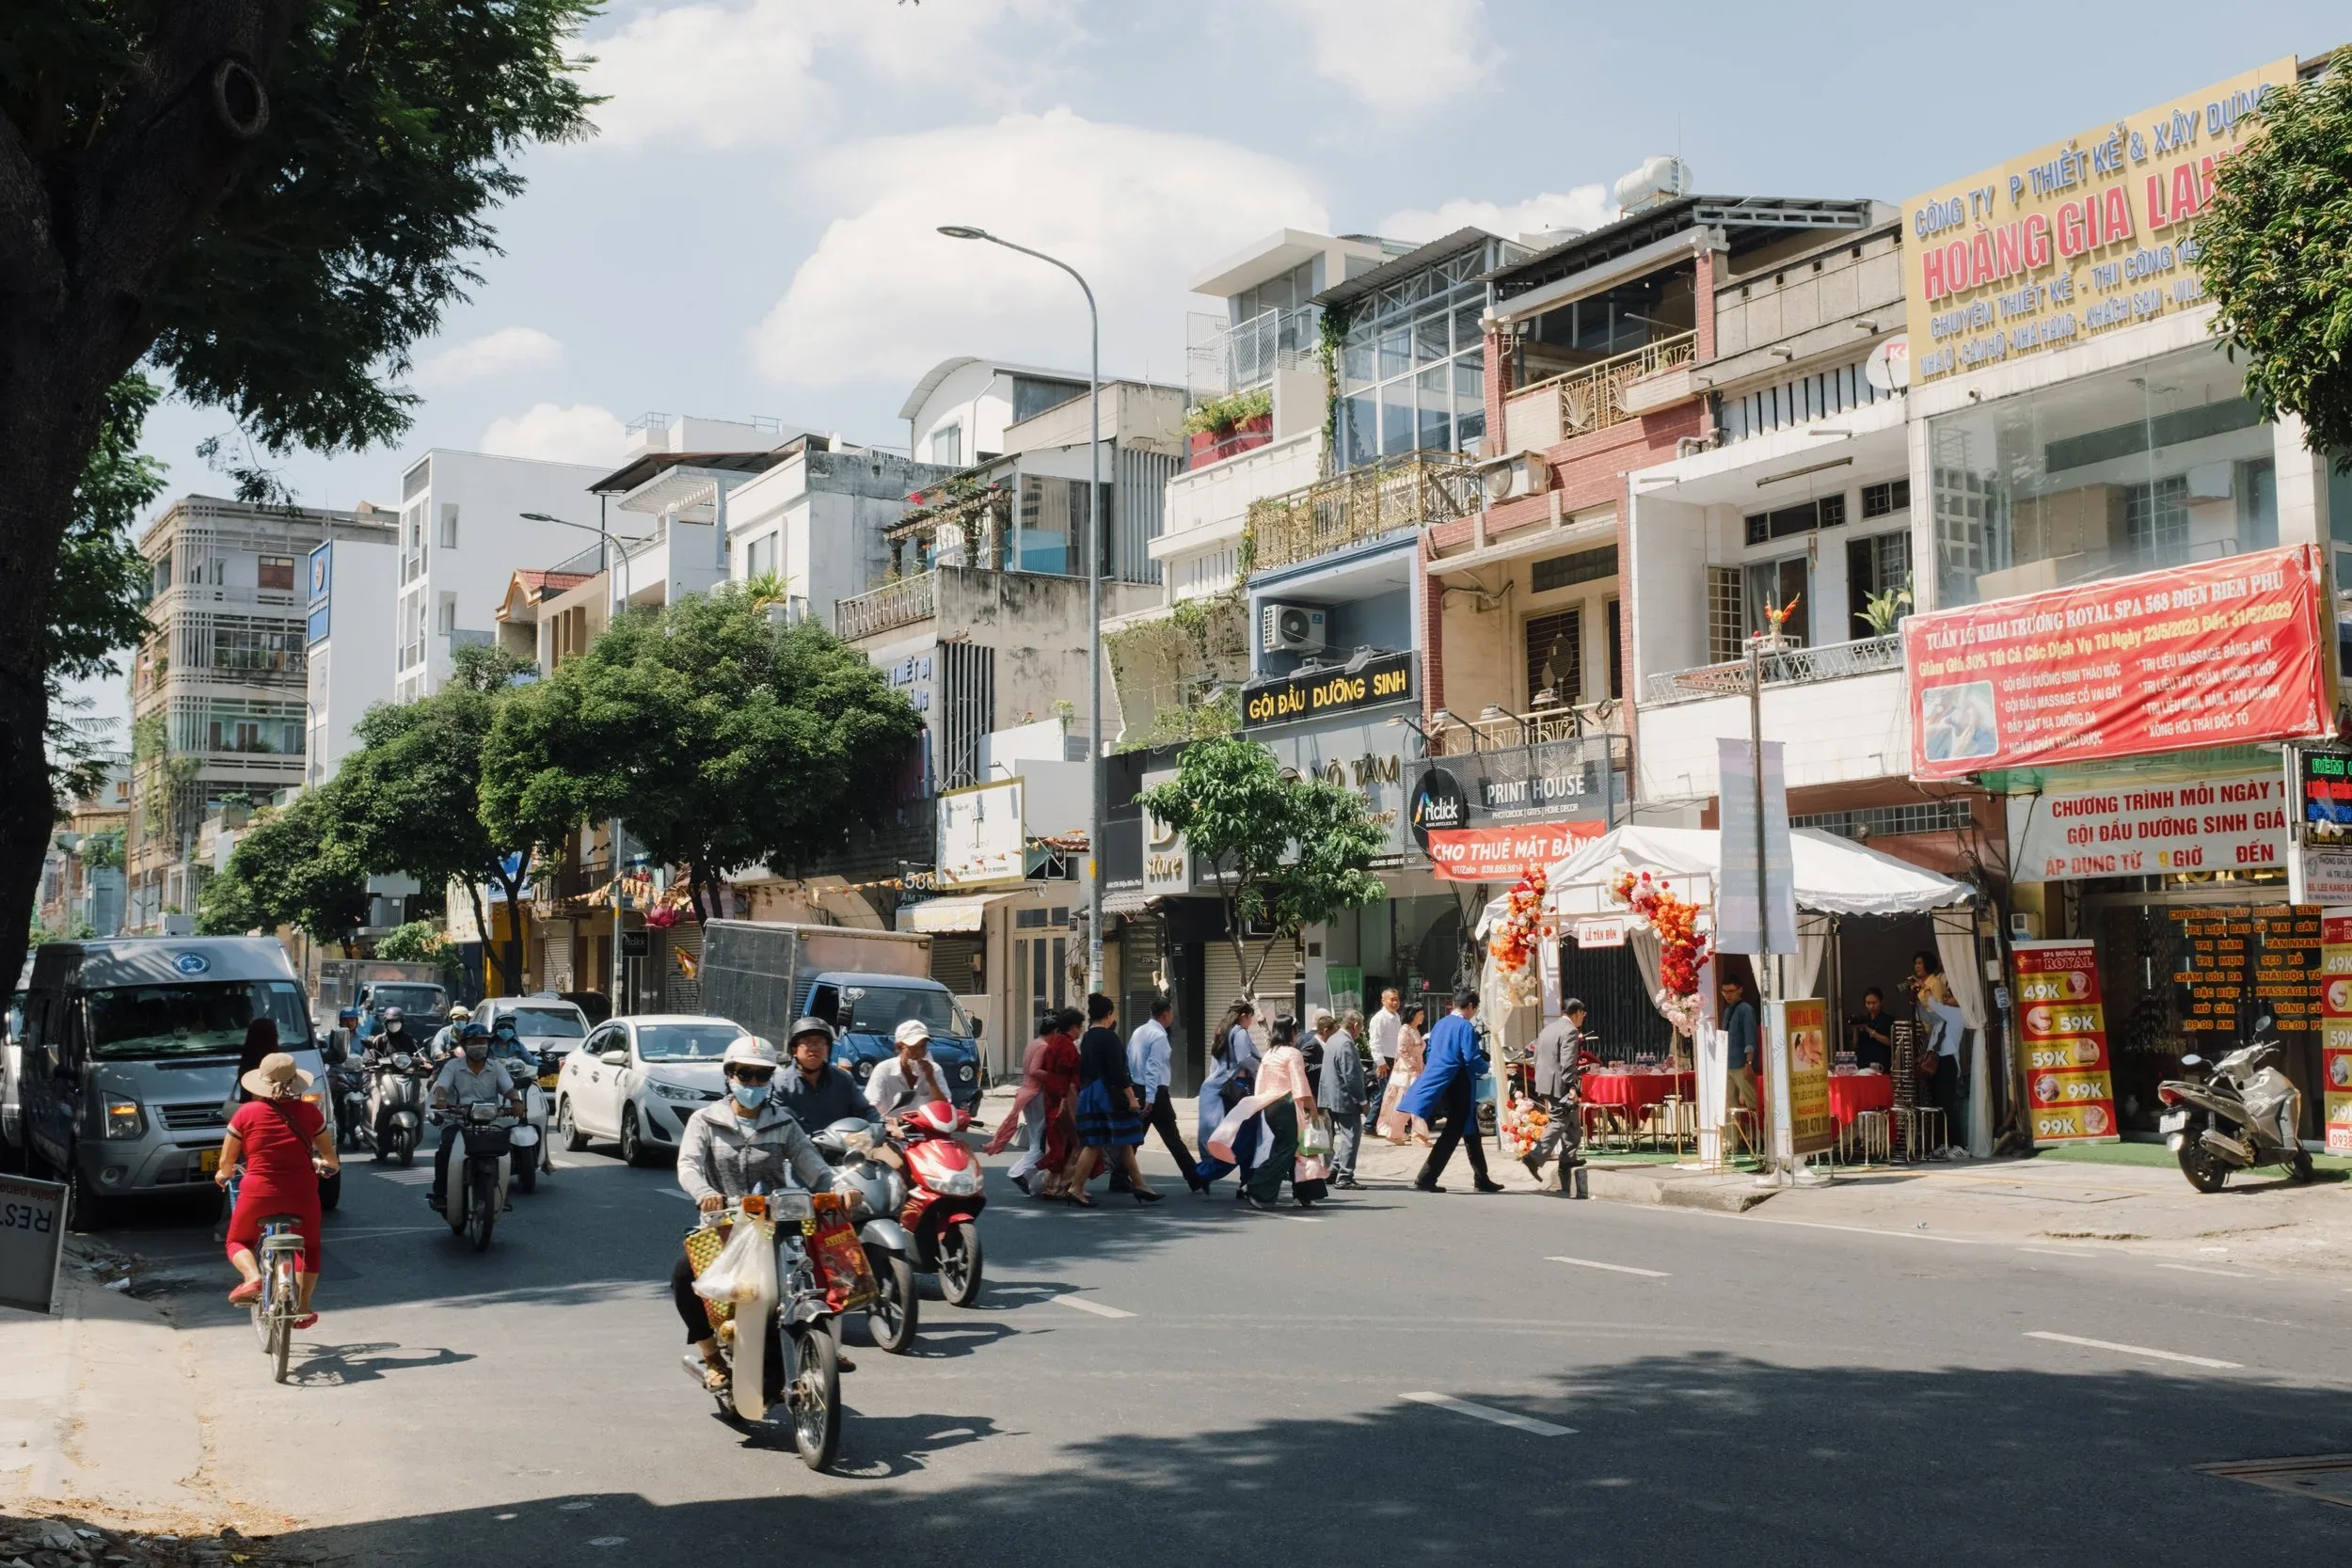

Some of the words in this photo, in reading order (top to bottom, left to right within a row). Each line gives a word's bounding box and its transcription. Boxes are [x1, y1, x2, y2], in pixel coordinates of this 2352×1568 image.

[1915, 198, 1963, 236] CÔNG
[1968, 185, 1994, 216] TY
[2028, 139, 2085, 195] THIẾT
[2093, 120, 2126, 173] KẾ
[2130, 131, 2144, 161] &
[2153, 108, 2197, 154] XÂY
[1922, 214, 2050, 301] HOÀNG
[2056, 184, 2133, 259] GIA
[1931, 299, 1992, 338] CHUYÊN
[1998, 276, 2042, 316] THIẾT
[2049, 264, 2073, 301] KẾ
[2091, 262, 2119, 288] THI
[2124, 245, 2171, 279] CÔNG
[1927, 622, 1959, 651] TUẦN
[1961, 618, 1976, 645] LỄ
[1977, 622, 2009, 642] KHAI
[2066, 605, 2110, 627] ROYAL
[2115, 599, 2143, 620] SPA
[2145, 592, 2169, 614] 568
[2172, 580, 2207, 611] ĐIỆN
[2212, 574, 2247, 601] BIÊN
[1249, 691, 1275, 721] GỘI
[1278, 684, 1306, 714] ĐẦU
[1313, 677, 1366, 708] DƯỠNG
[1374, 670, 1406, 695] SINH
[2312, 755, 2344, 775] RÈM
[1486, 780, 1528, 804] PRINT
[1533, 773, 1585, 800] HOUSE
[2052, 796, 2119, 817] CHƯƠNG
[2123, 790, 2174, 812] TRÌNH
[2180, 781, 2215, 807] MỖI
[2220, 780, 2271, 803] NGÀY
[2067, 825, 2093, 847] GỘI
[2099, 817, 2133, 842] ĐẦU
[2138, 816, 2198, 838] DƯỠNG
[2203, 813, 2248, 833] SINH
[2254, 807, 2285, 831] GIÁ
[1433, 842, 1465, 862] CHO
[1470, 837, 1512, 861] THUÊ
[1515, 833, 1548, 863] MẶT
[2045, 856, 2065, 877] ÁP
[2072, 854, 2116, 879] DỤNG
[2121, 850, 2143, 871] TỪ
[2173, 844, 2202, 867] GIỜ
[2235, 838, 2274, 863] ĐẾN
[2043, 956, 2094, 970] ROYAL
[2024, 983, 2061, 1000] 49K
[2257, 987, 2307, 996] MASSAGE
[2059, 1015, 2096, 1032] 59K
[2032, 1051, 2070, 1068] 59K
[2067, 1083, 2106, 1099] 99K
[2039, 1118, 2077, 1135] 99K
[0, 1203, 53, 1233] RES
